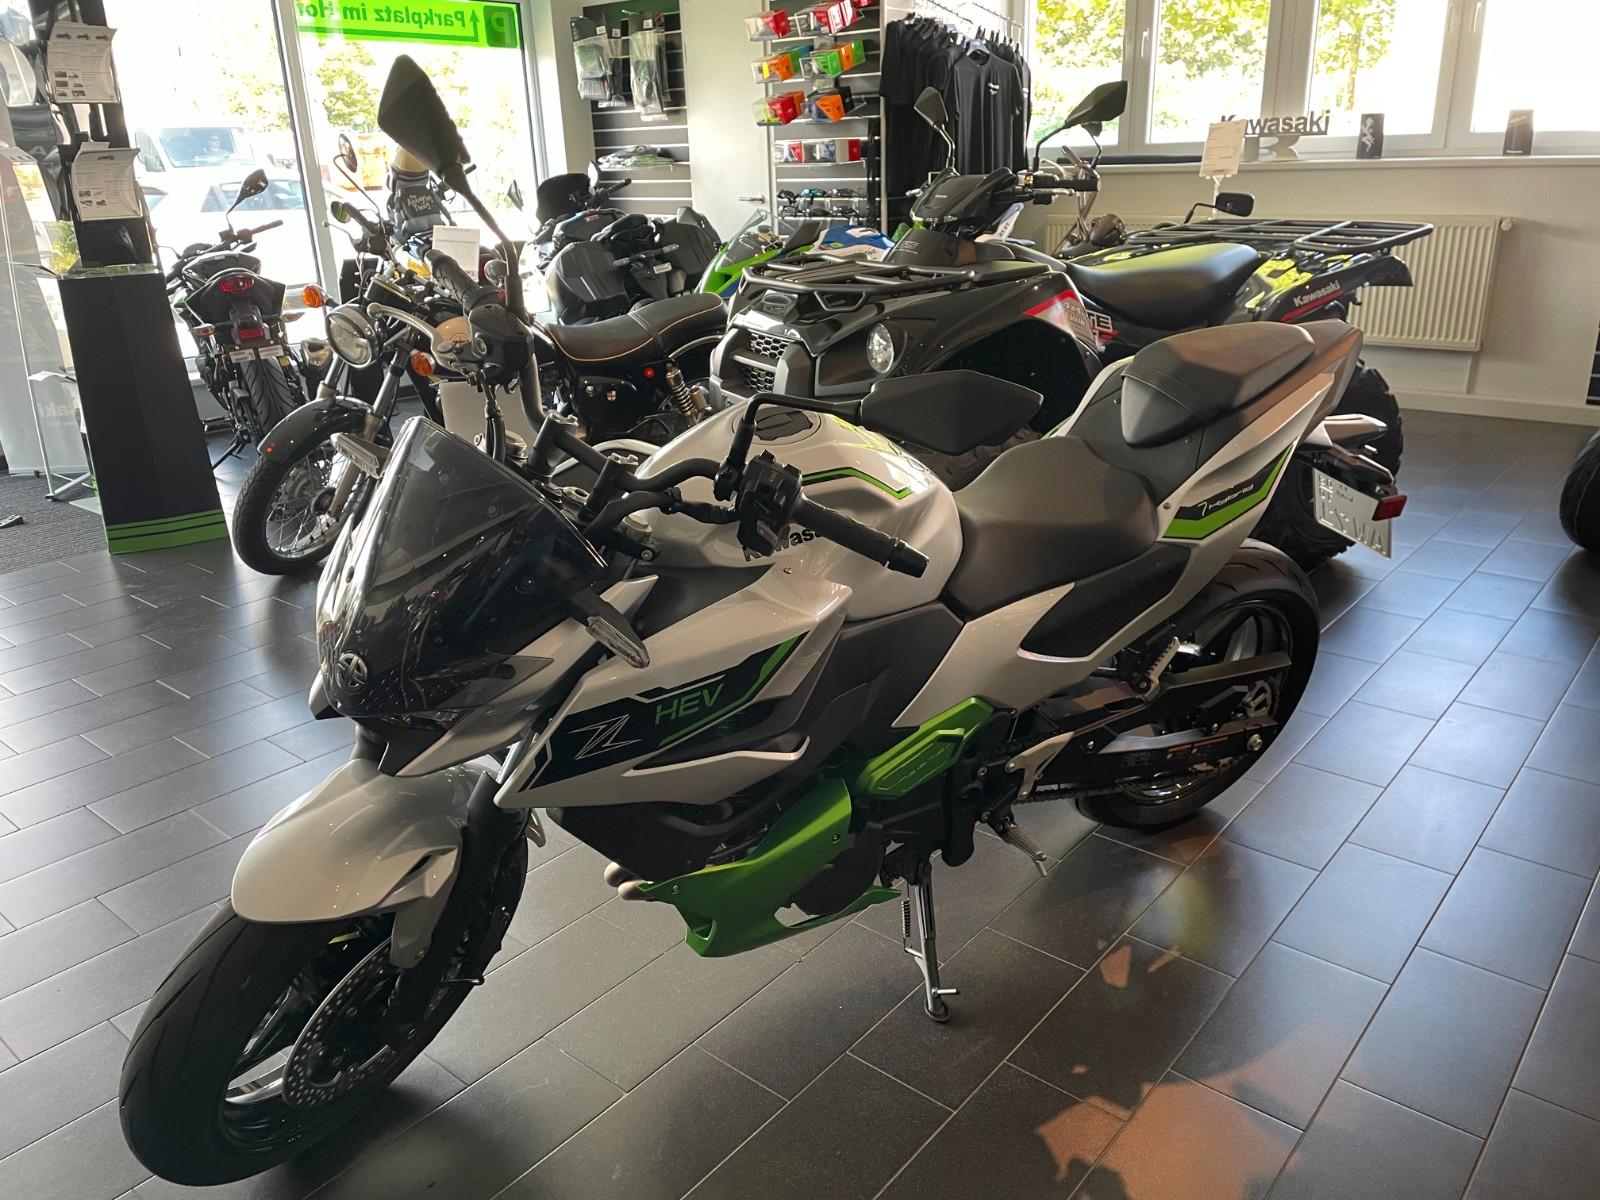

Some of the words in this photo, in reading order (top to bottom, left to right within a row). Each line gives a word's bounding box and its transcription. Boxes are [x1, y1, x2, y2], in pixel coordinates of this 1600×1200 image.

[1221, 110, 1331, 136] wasaki
[1293, 280, 1341, 308] Kawasaki
[655, 682, 725, 725] HEV
